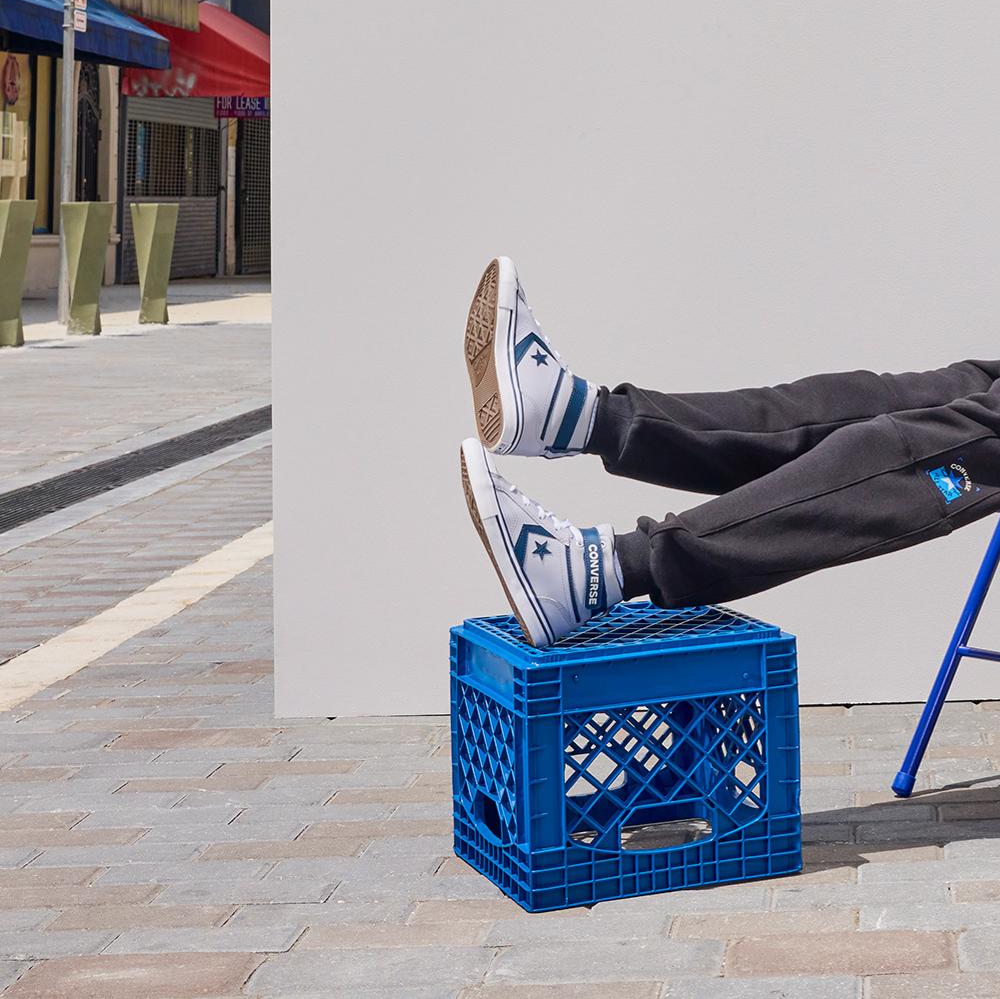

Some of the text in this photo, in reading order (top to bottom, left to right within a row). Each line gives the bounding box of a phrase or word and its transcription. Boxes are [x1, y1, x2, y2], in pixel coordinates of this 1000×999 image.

[216, 96, 232, 109] FOR
[236, 96, 261, 110] LEASE
[588, 544, 600, 605] CONVERSE
